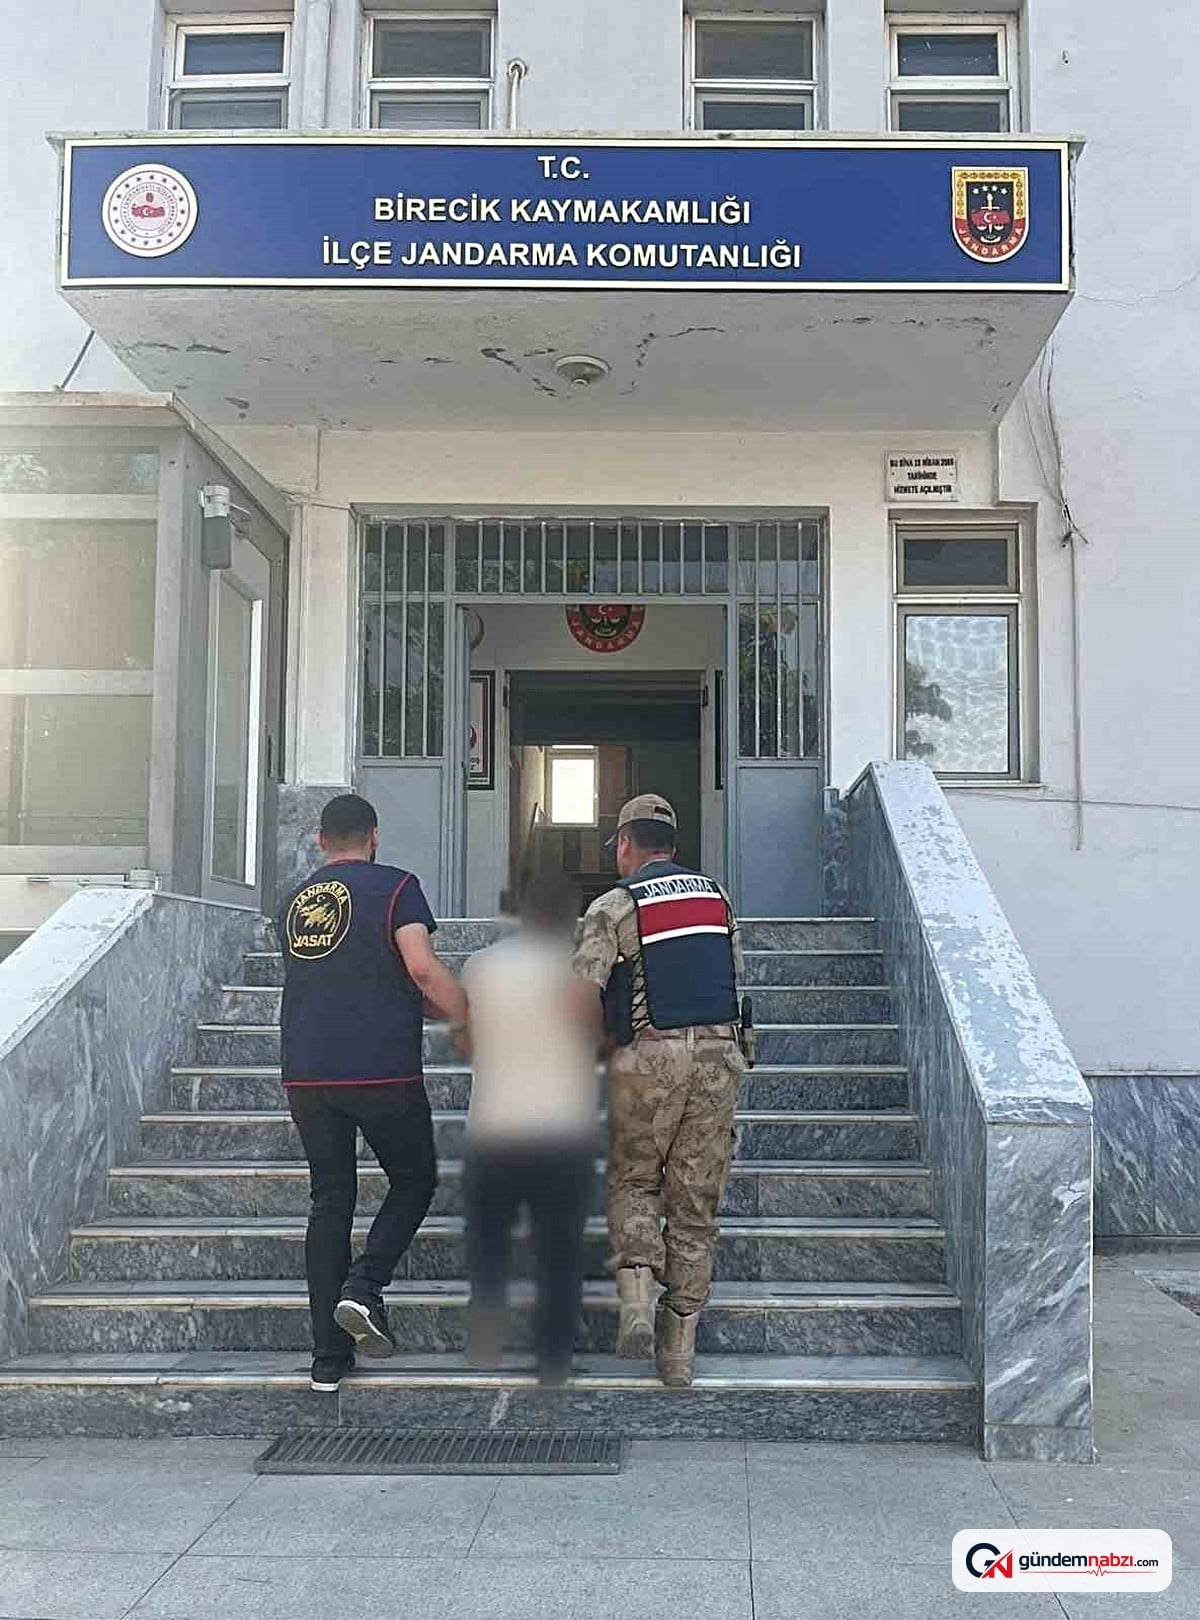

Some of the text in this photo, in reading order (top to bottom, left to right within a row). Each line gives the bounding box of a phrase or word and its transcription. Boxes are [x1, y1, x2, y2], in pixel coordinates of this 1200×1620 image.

[537, 155, 589, 179] T.C.
[374, 193, 750, 224] BİRECİK KAYMAKAMLIĞI
[323, 235, 801, 269] İLÇE JANDARMA KOMUTANLIĞI
[958, 227, 1024, 256] JANDARMA
[296, 883, 348, 909] JANDARMA
[644, 878, 713, 898] JANDARMA
[294, 933, 334, 948] JASAT
